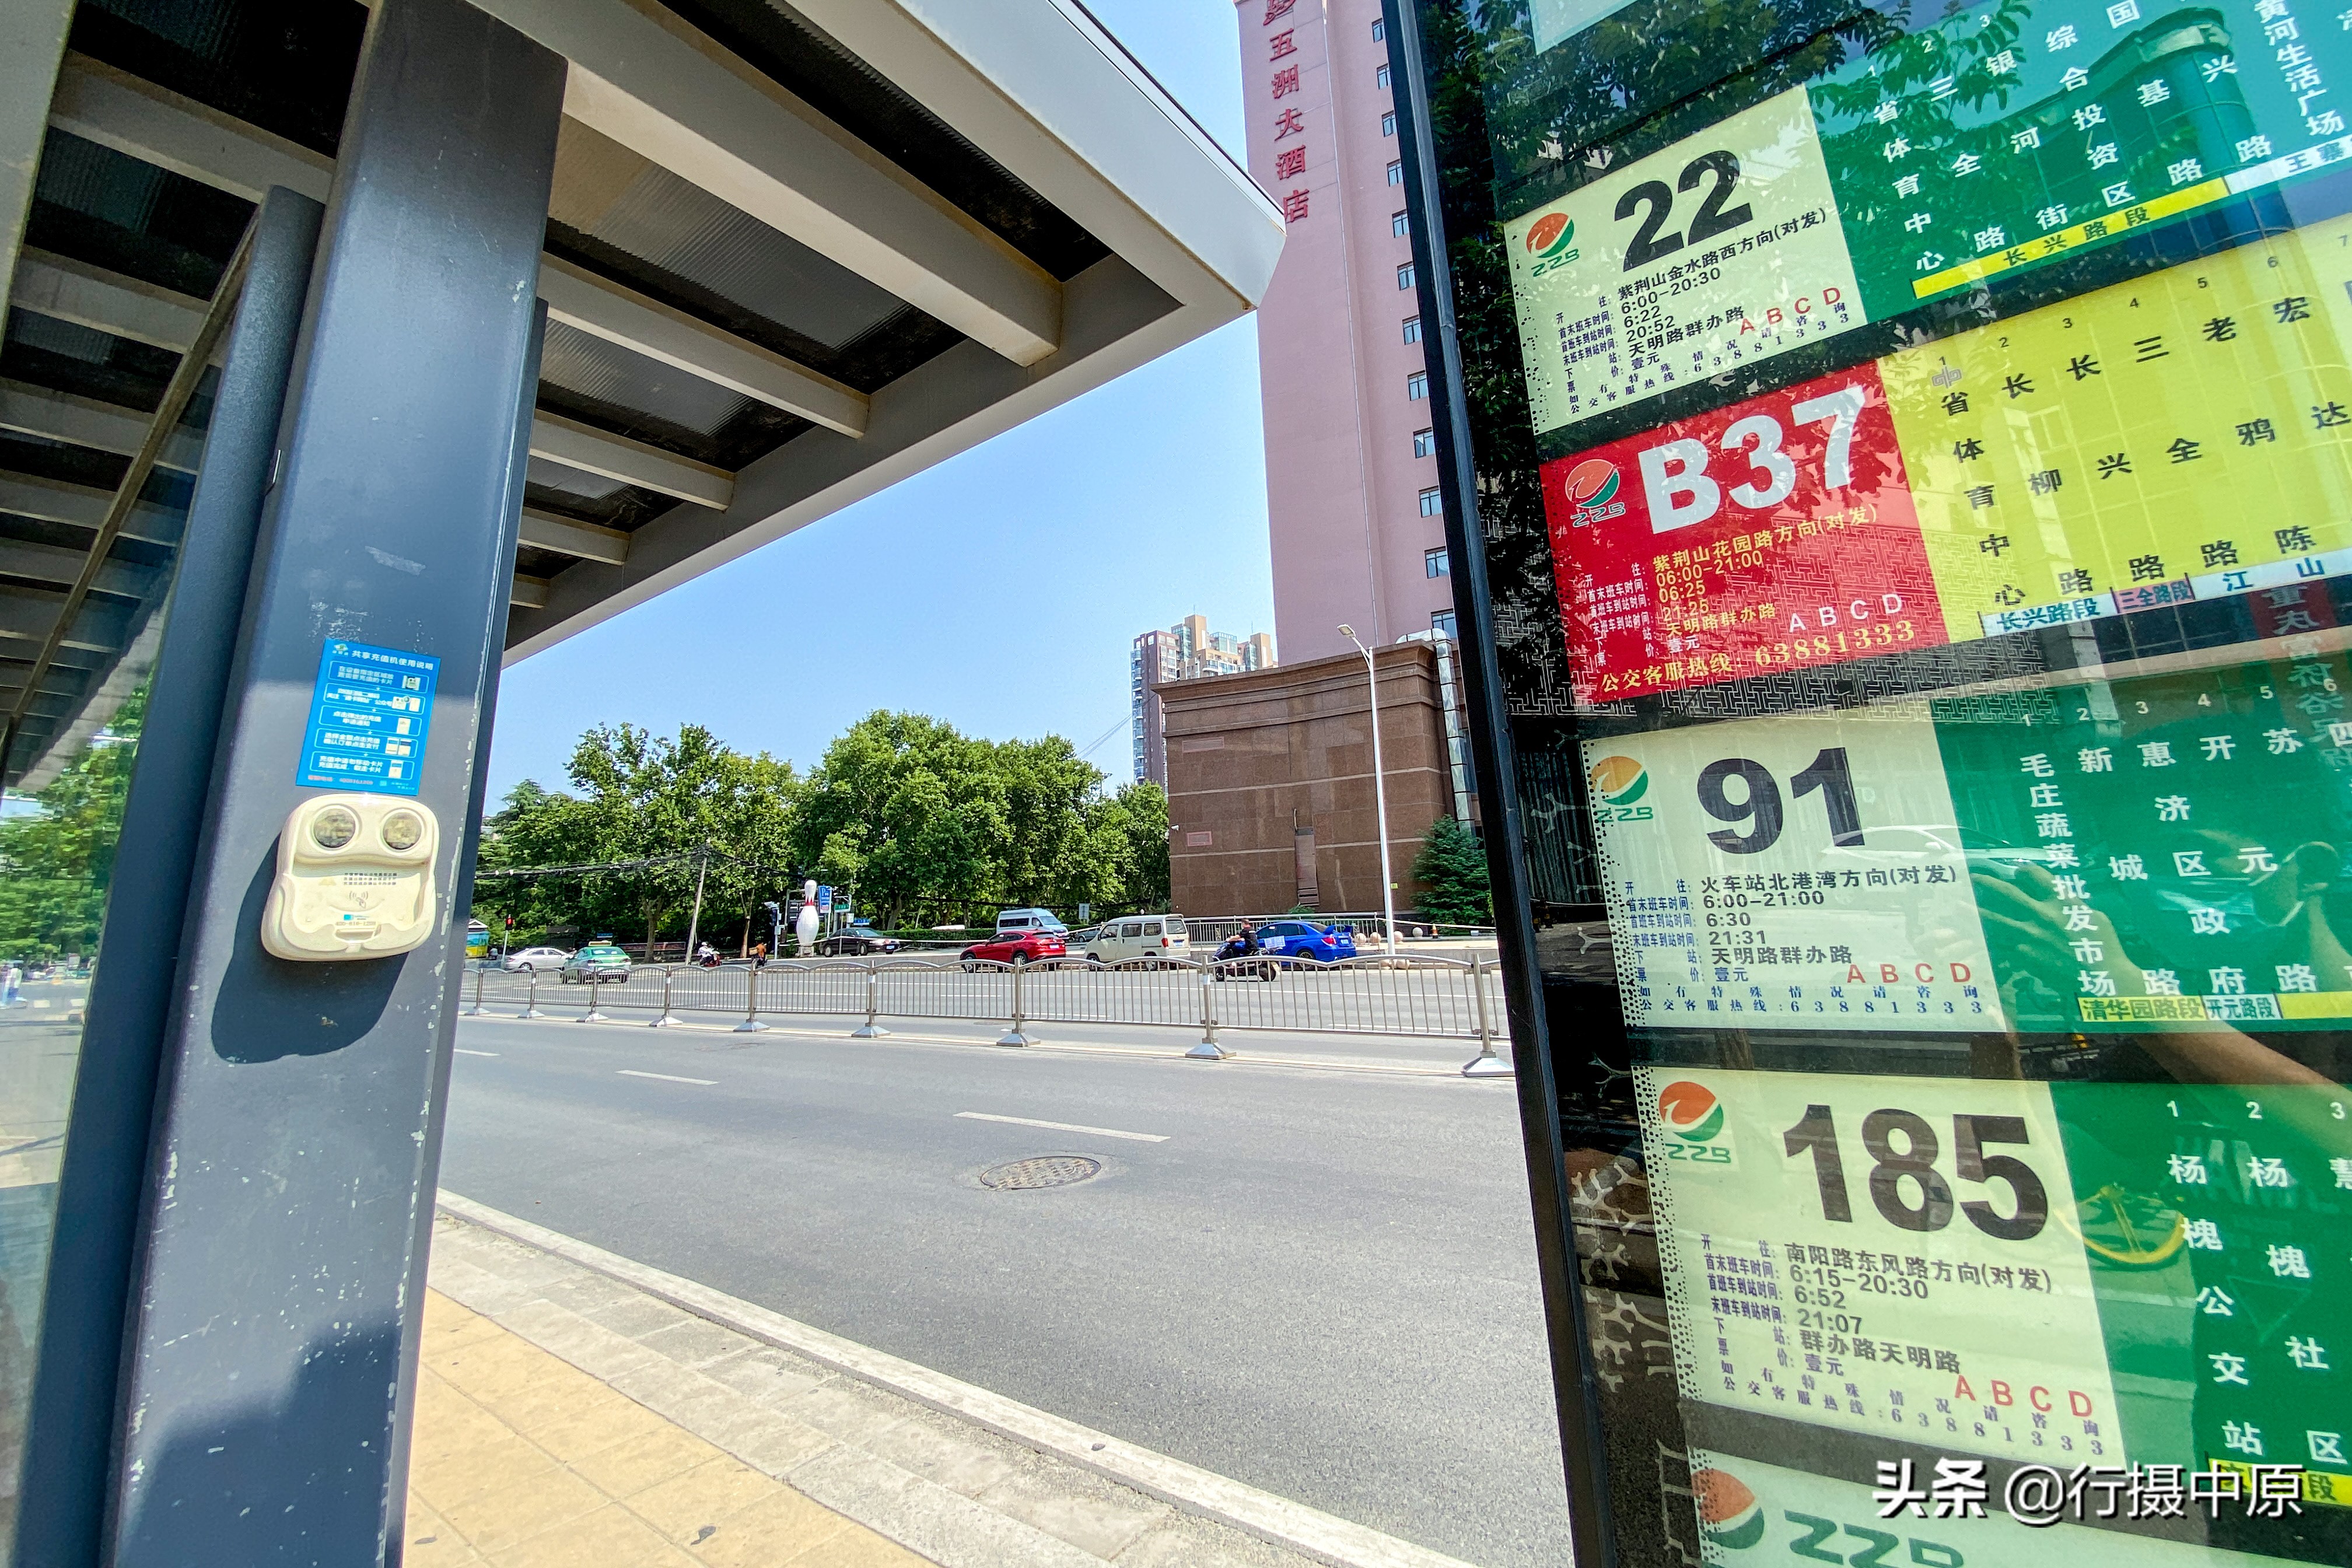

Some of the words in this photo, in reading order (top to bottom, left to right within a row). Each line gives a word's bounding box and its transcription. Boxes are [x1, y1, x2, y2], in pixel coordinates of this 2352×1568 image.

[1980, 15, 1990, 27] 3
[2254, 0, 2344, 136] 黄河生活广场
[2046, 24, 2136, 208] 综合投资区
[2106, 0, 2204, 186] 国基路
[1986, 49, 2068, 230] 银河街
[1874, 100, 1945, 270] 省体育中心
[1929, 75, 2005, 252] 三全路
[1614, 150, 1753, 272] 22
[1618, 207, 1826, 301] 紫荆山金水路西方向(对发)
[2003, 206, 2150, 266] 长兴路段
[1621, 267, 1721, 314] 6:00-20:30
[1740, 318, 1755, 335] A
[1766, 307, 1783, 325] B
[1794, 298, 1811, 314] C
[1823, 288, 1840, 305] D
[1938, 356, 1947, 366] 1
[1999, 337, 2010, 348] 2
[2062, 318, 2074, 329] 3
[2130, 298, 2139, 309] 4
[2197, 277, 2208, 289] 5
[2267, 256, 2278, 268] 6
[1624, 306, 1661, 328] 6:22
[1626, 316, 1675, 342] 20:52
[1629, 306, 1744, 358] 天明路群办路
[1632, 352, 1660, 370] 壹元
[2134, 336, 2238, 568] 三全路
[2203, 317, 2316, 554] 老鸦陈
[1637, 385, 1866, 534] B37
[2066, 355, 2165, 582] 长兴路
[1941, 393, 2025, 606] 省体育中心
[2002, 373, 2094, 594] 长柳路
[1653, 503, 1877, 573] 紫荆山花园路方向(对发)
[1656, 550, 1762, 587] 06:00-21:00
[1658, 580, 1705, 603] 06:25
[2222, 557, 2325, 592] 江山
[1662, 600, 1709, 621] 21:25
[1788, 613, 1806, 634] A
[1819, 606, 1837, 628] B
[1850, 600, 1870, 621] C
[1882, 593, 1903, 614] D
[1996, 597, 2100, 631] 长兴路段
[2119, 583, 2193, 609] 三全路段
[1667, 603, 1776, 637] 天明路群办路
[1755, 620, 1915, 668] 63881333
[2077, 708, 2090, 721] 2
[2136, 701, 2150, 715] 3
[2198, 694, 2211, 708] 4
[2260, 686, 2273, 699] 5
[2324, 678, 2337, 692] 6
[1698, 747, 1866, 854] 91
[1701, 864, 1956, 893] 火车站北港湾方向(对发)
[2020, 754, 2118, 997] 毛庄蔬菜批发市场
[2078, 747, 2182, 995] 新城路
[2136, 741, 2247, 995] 惠济区政府
[2199, 734, 2318, 992] 开元路
[1703, 891, 1824, 908] 6:00-21:00
[1706, 912, 1751, 926] 6:30
[1709, 930, 1766, 945] 21:31
[1711, 946, 1852, 965] 天明路群办路
[1714, 967, 1748, 982] 壹元
[1847, 964, 1866, 984] A
[1880, 964, 1899, 984] B
[1915, 963, 1934, 983] C
[1950, 963, 1971, 983] D
[2082, 998, 2202, 1020] 清华园路段
[2207, 994, 2274, 1019] 开元路段
[2166, 1101, 2180, 1118] 1
[2246, 1102, 2262, 1119] 2
[2330, 1102, 2346, 1119] 3
[1782, 1104, 2049, 1241] 185
[1784, 1242, 2051, 1294] 南阳路东风路方向(对发)
[1790, 1264, 1928, 1298] 6:15-20:30
[1795, 1285, 1846, 1309] 6:52
[2166, 1154, 2263, 1456] 杨槐公交站
[2247, 1156, 2348, 1464] 杨槐社区
[1797, 1308, 1862, 1334] 21:07
[1799, 1329, 1960, 1374] 群办路天明路
[1805, 1354, 1843, 1376] 壹元
[1954, 1375, 1976, 1401] A
[1991, 1380, 2013, 1406] B
[2029, 1386, 2052, 1412] C
[2068, 1390, 2092, 1417] D
